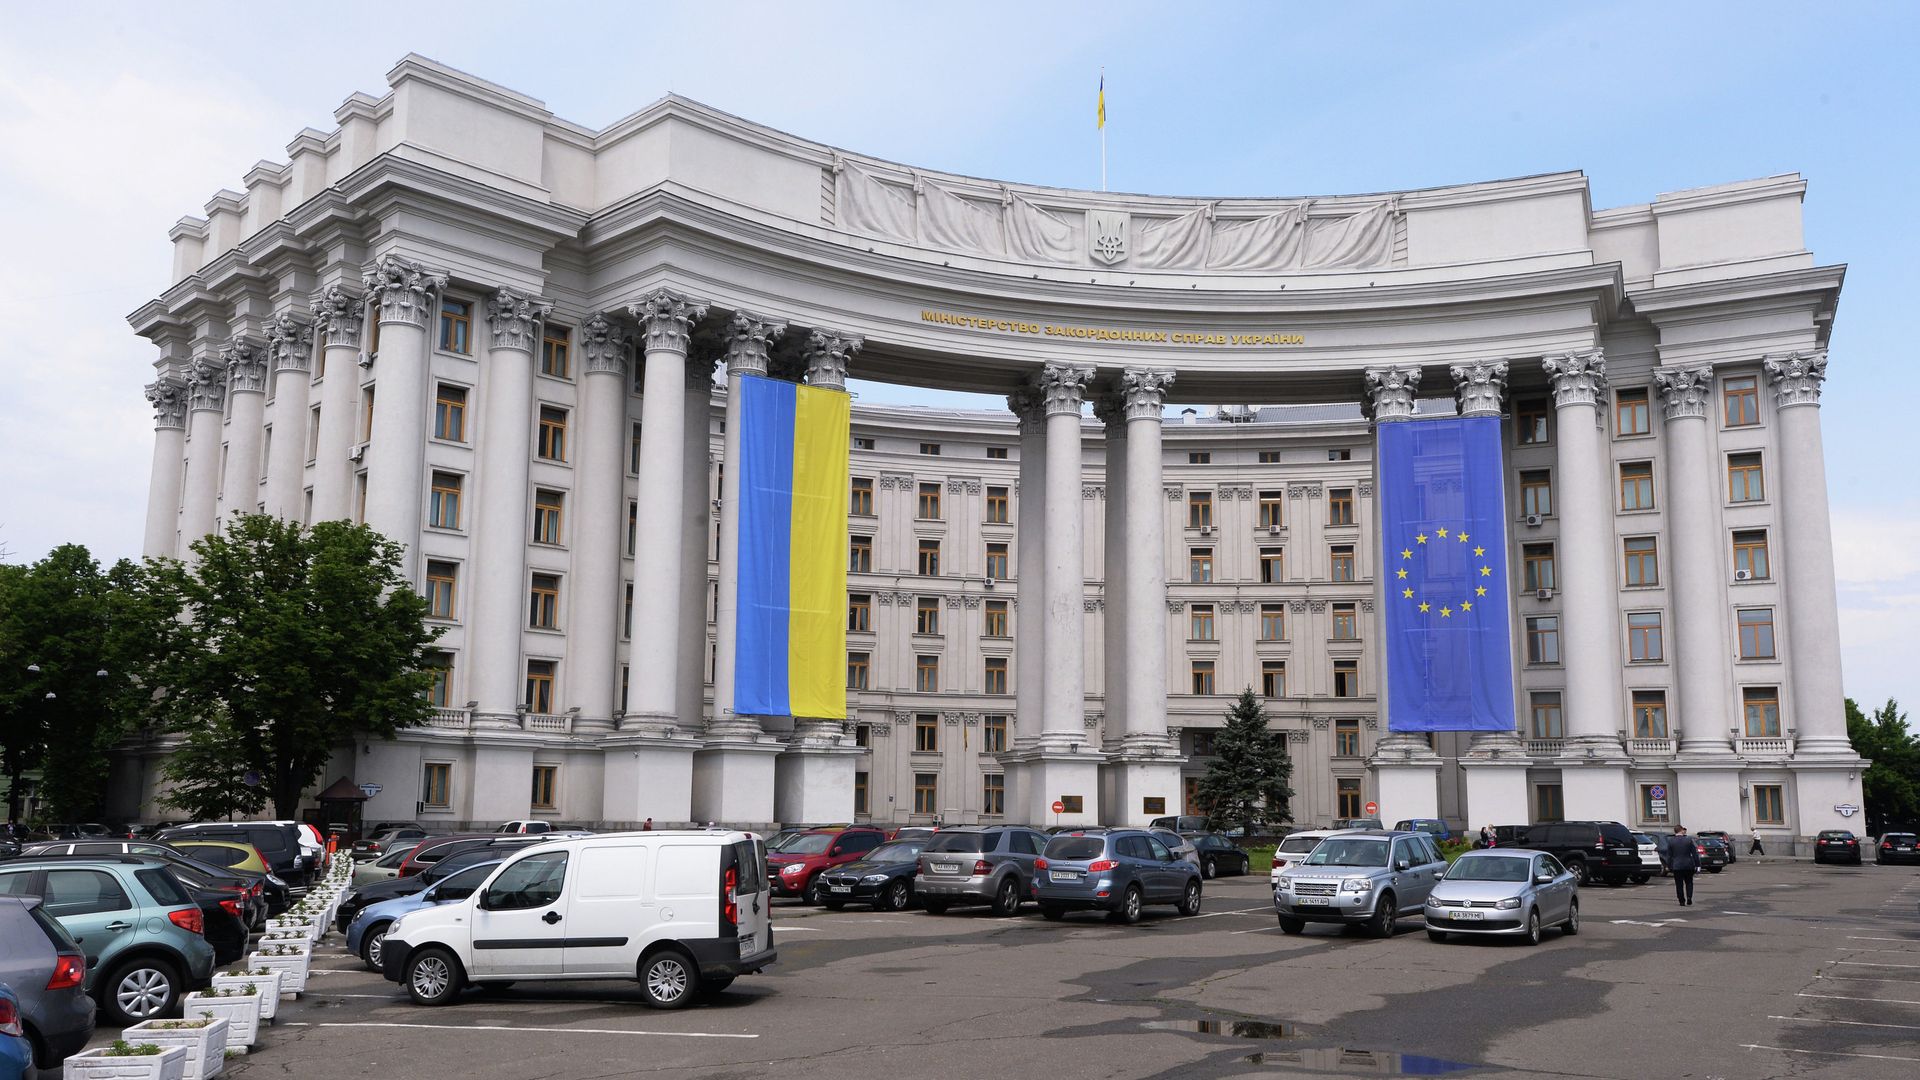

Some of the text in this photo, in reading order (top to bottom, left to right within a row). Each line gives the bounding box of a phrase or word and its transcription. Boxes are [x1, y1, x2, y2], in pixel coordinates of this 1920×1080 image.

[921, 309, 1304, 345] МІНІСТЕРСТВО ЗАКОРДОННИХ СПРАВ УКРАЇНИ
